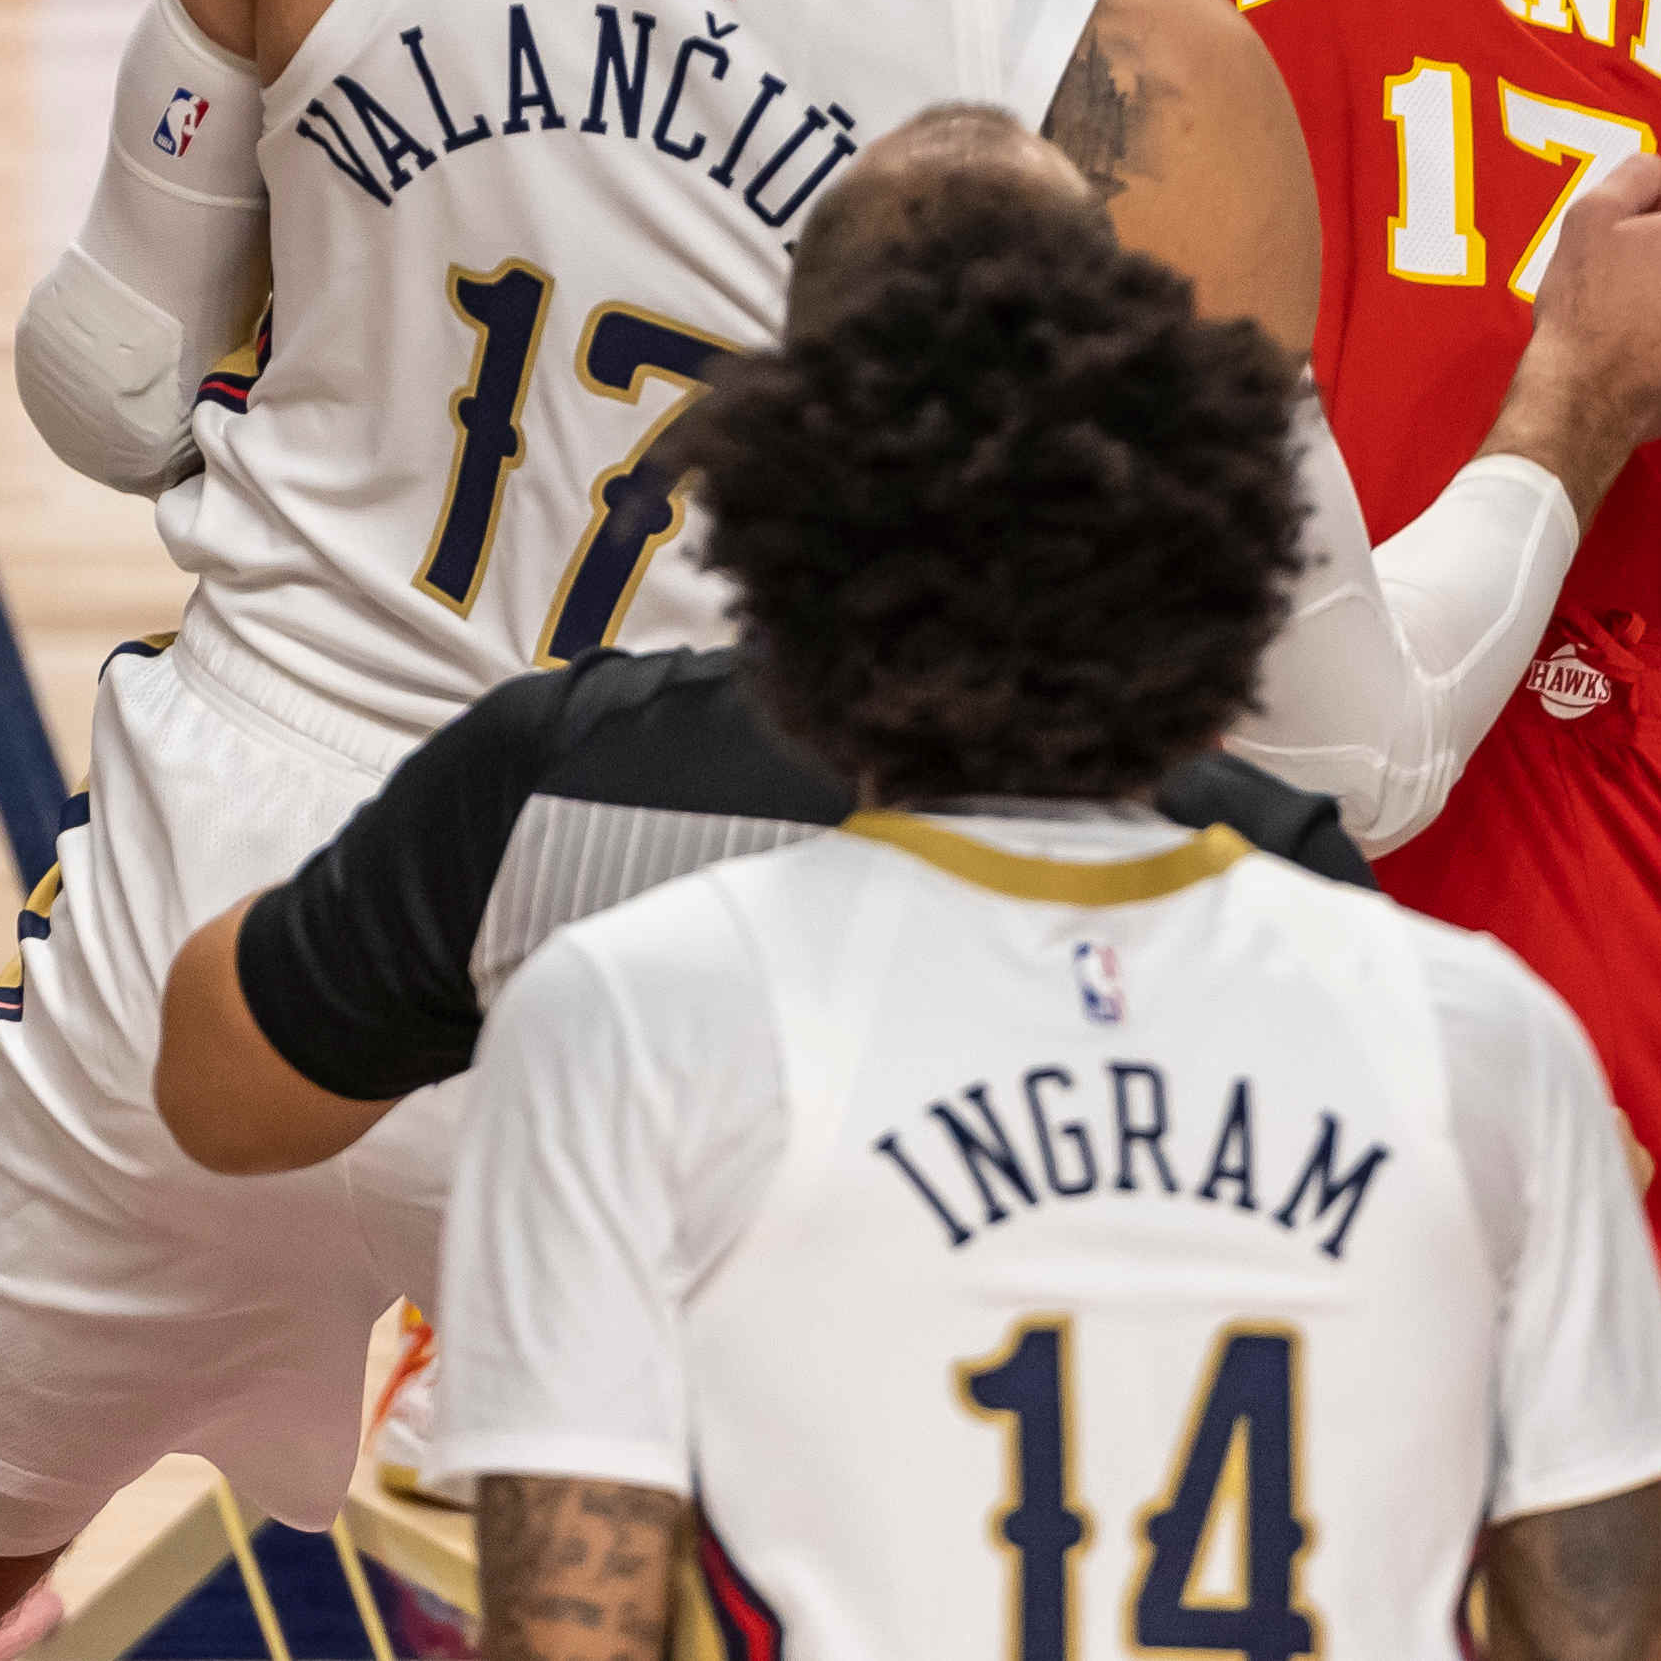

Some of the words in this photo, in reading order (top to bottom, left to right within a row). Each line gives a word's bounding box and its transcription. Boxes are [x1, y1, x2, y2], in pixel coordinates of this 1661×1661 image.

[297, 4, 858, 244] VALANČIŪ
[1382, 55, 1658, 306] 17
[412, 254, 748, 670] 17
[1528, 660, 1612, 702] HAWKS
[873, 1060, 1395, 1261] INGRAM
[953, 1312, 1324, 1661] 14
